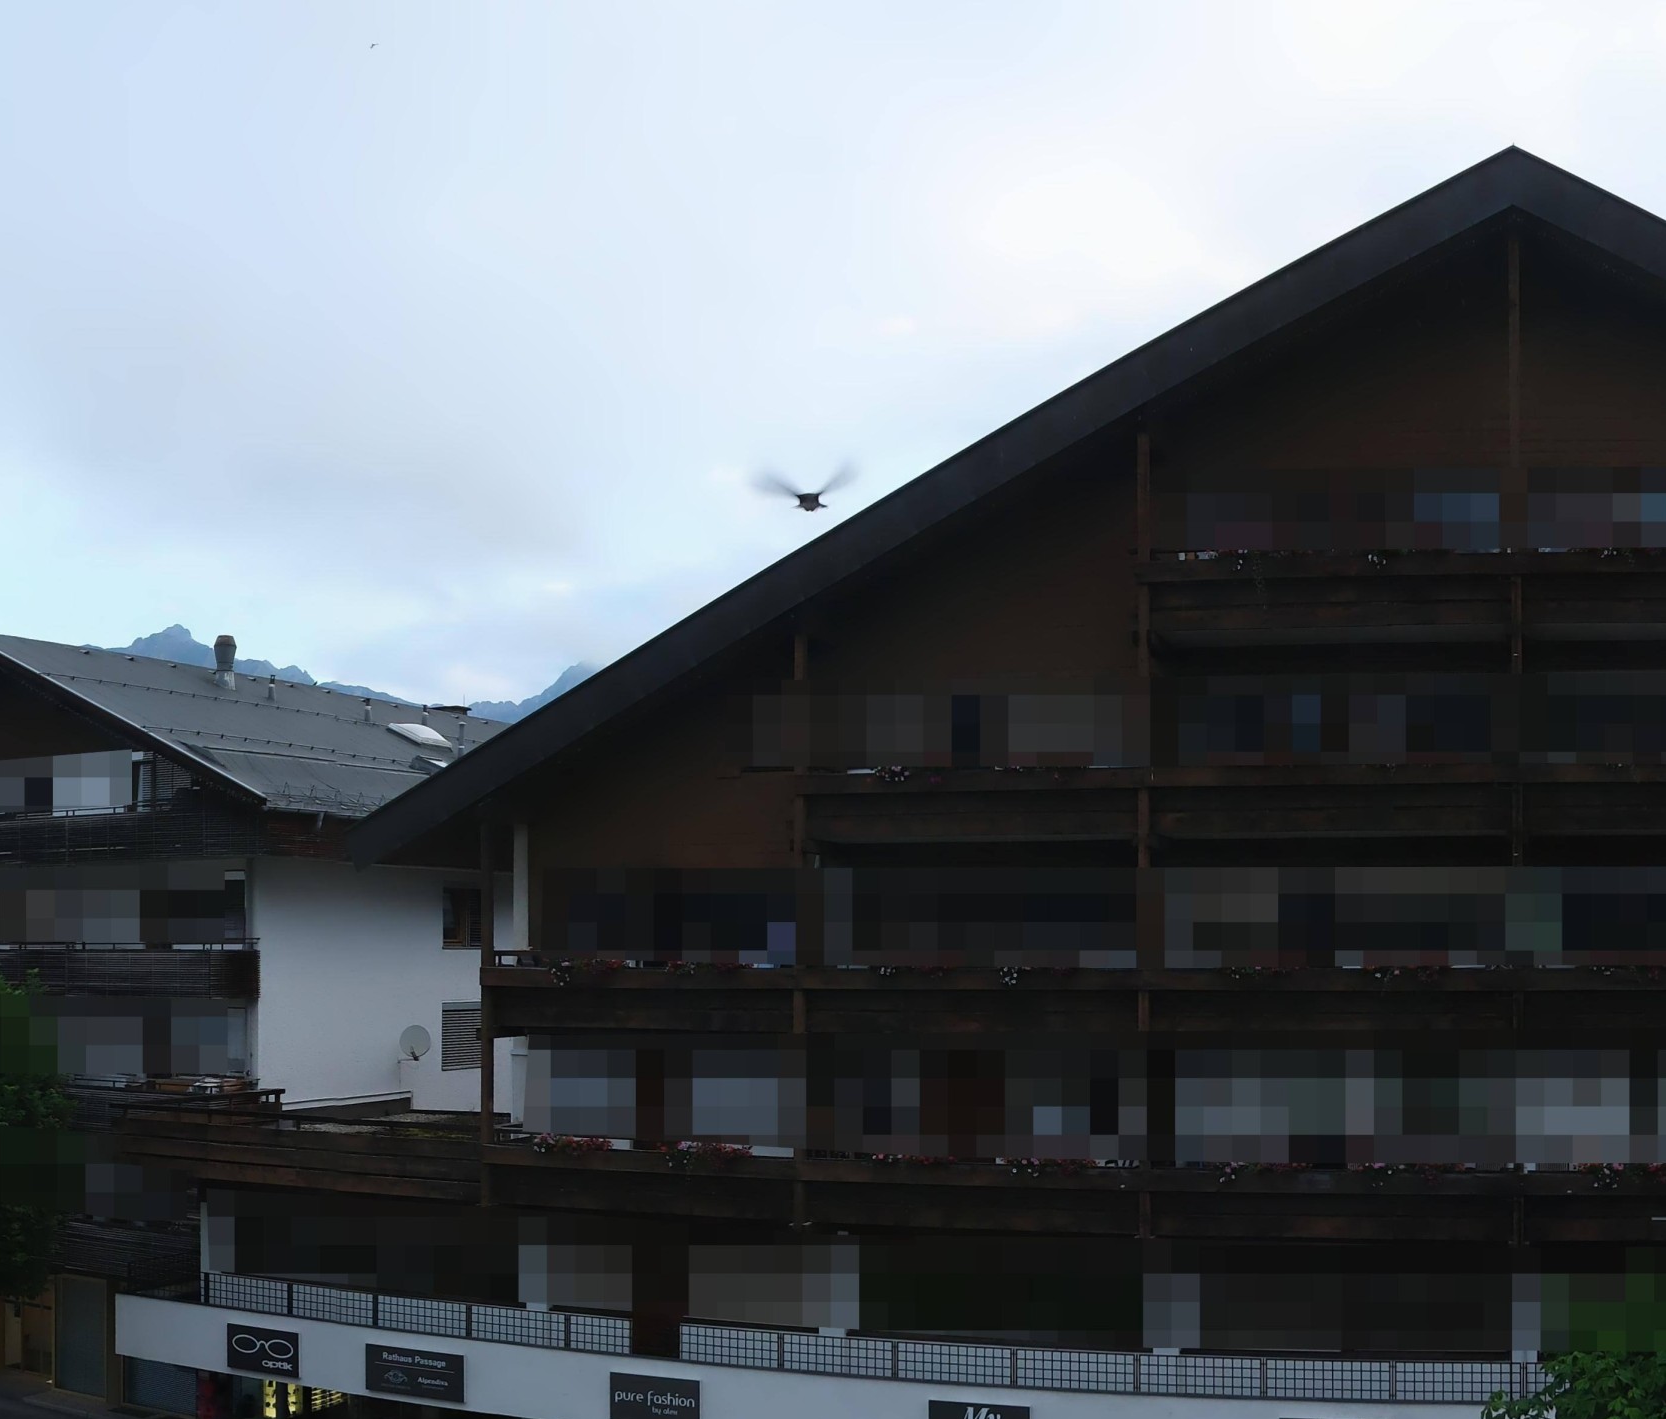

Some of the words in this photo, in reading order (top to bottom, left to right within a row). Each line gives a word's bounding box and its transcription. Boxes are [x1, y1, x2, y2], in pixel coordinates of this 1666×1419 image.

[262, 1360, 293, 1371] optik
[382, 1351, 412, 1363] Rathaus
[414, 1356, 446, 1368] Passage
[615, 1390, 644, 1403] pure
[647, 1390, 695, 1408] fashion
